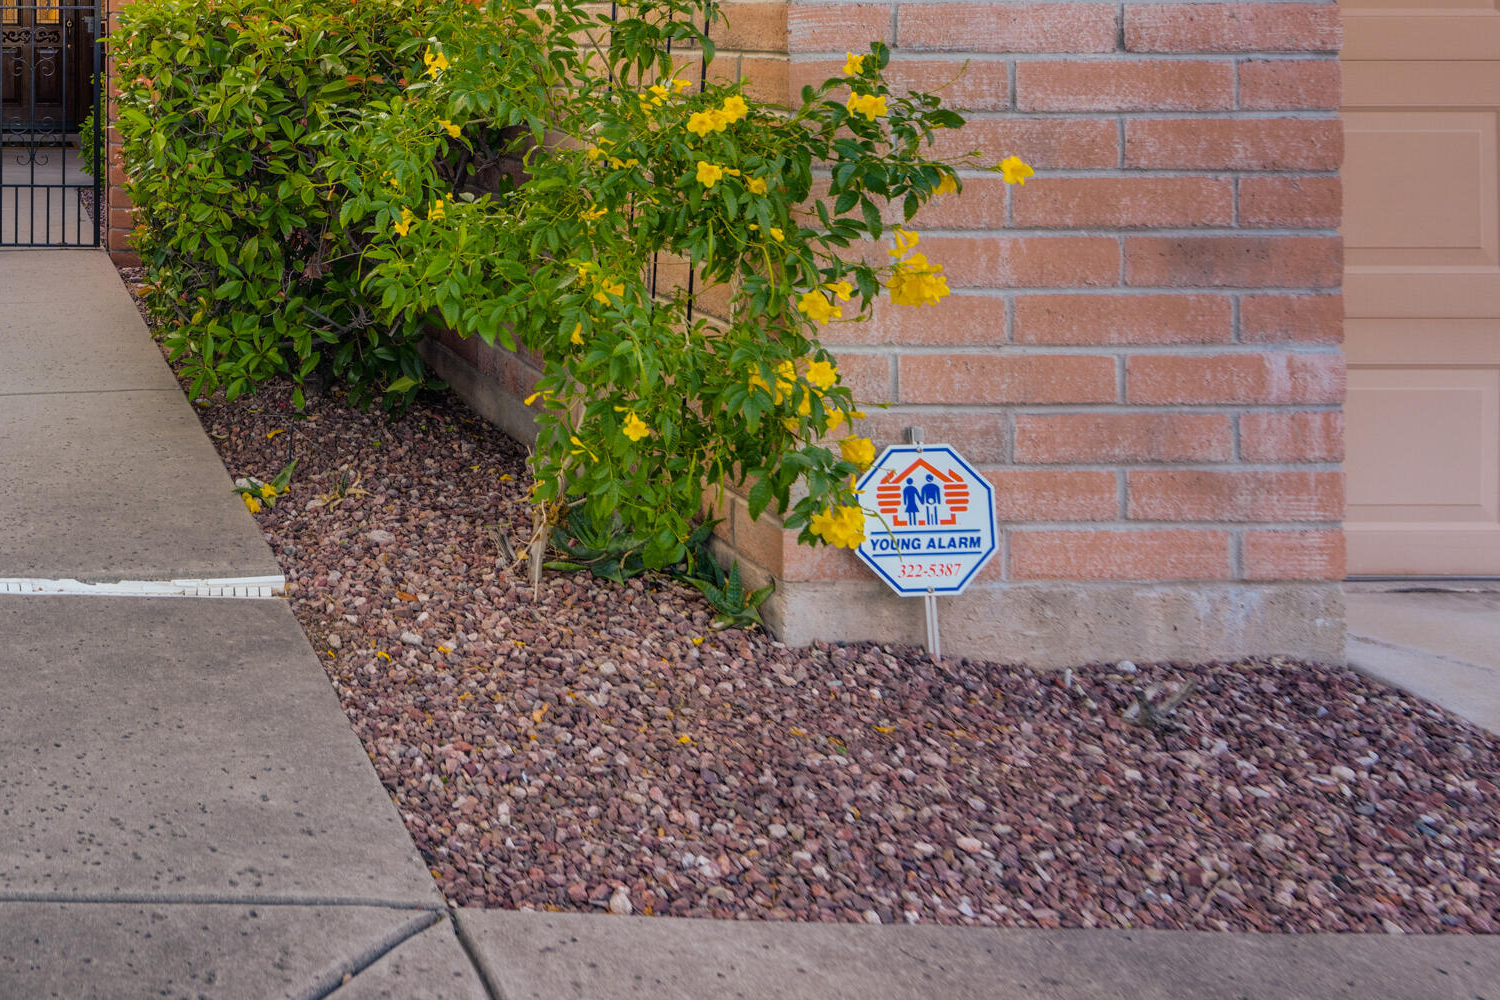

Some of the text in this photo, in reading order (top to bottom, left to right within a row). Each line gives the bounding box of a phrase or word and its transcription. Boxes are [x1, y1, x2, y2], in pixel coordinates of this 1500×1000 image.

[870, 536, 982, 551] YOUNG ALARM
[898, 563, 962, 578] 322-5387
